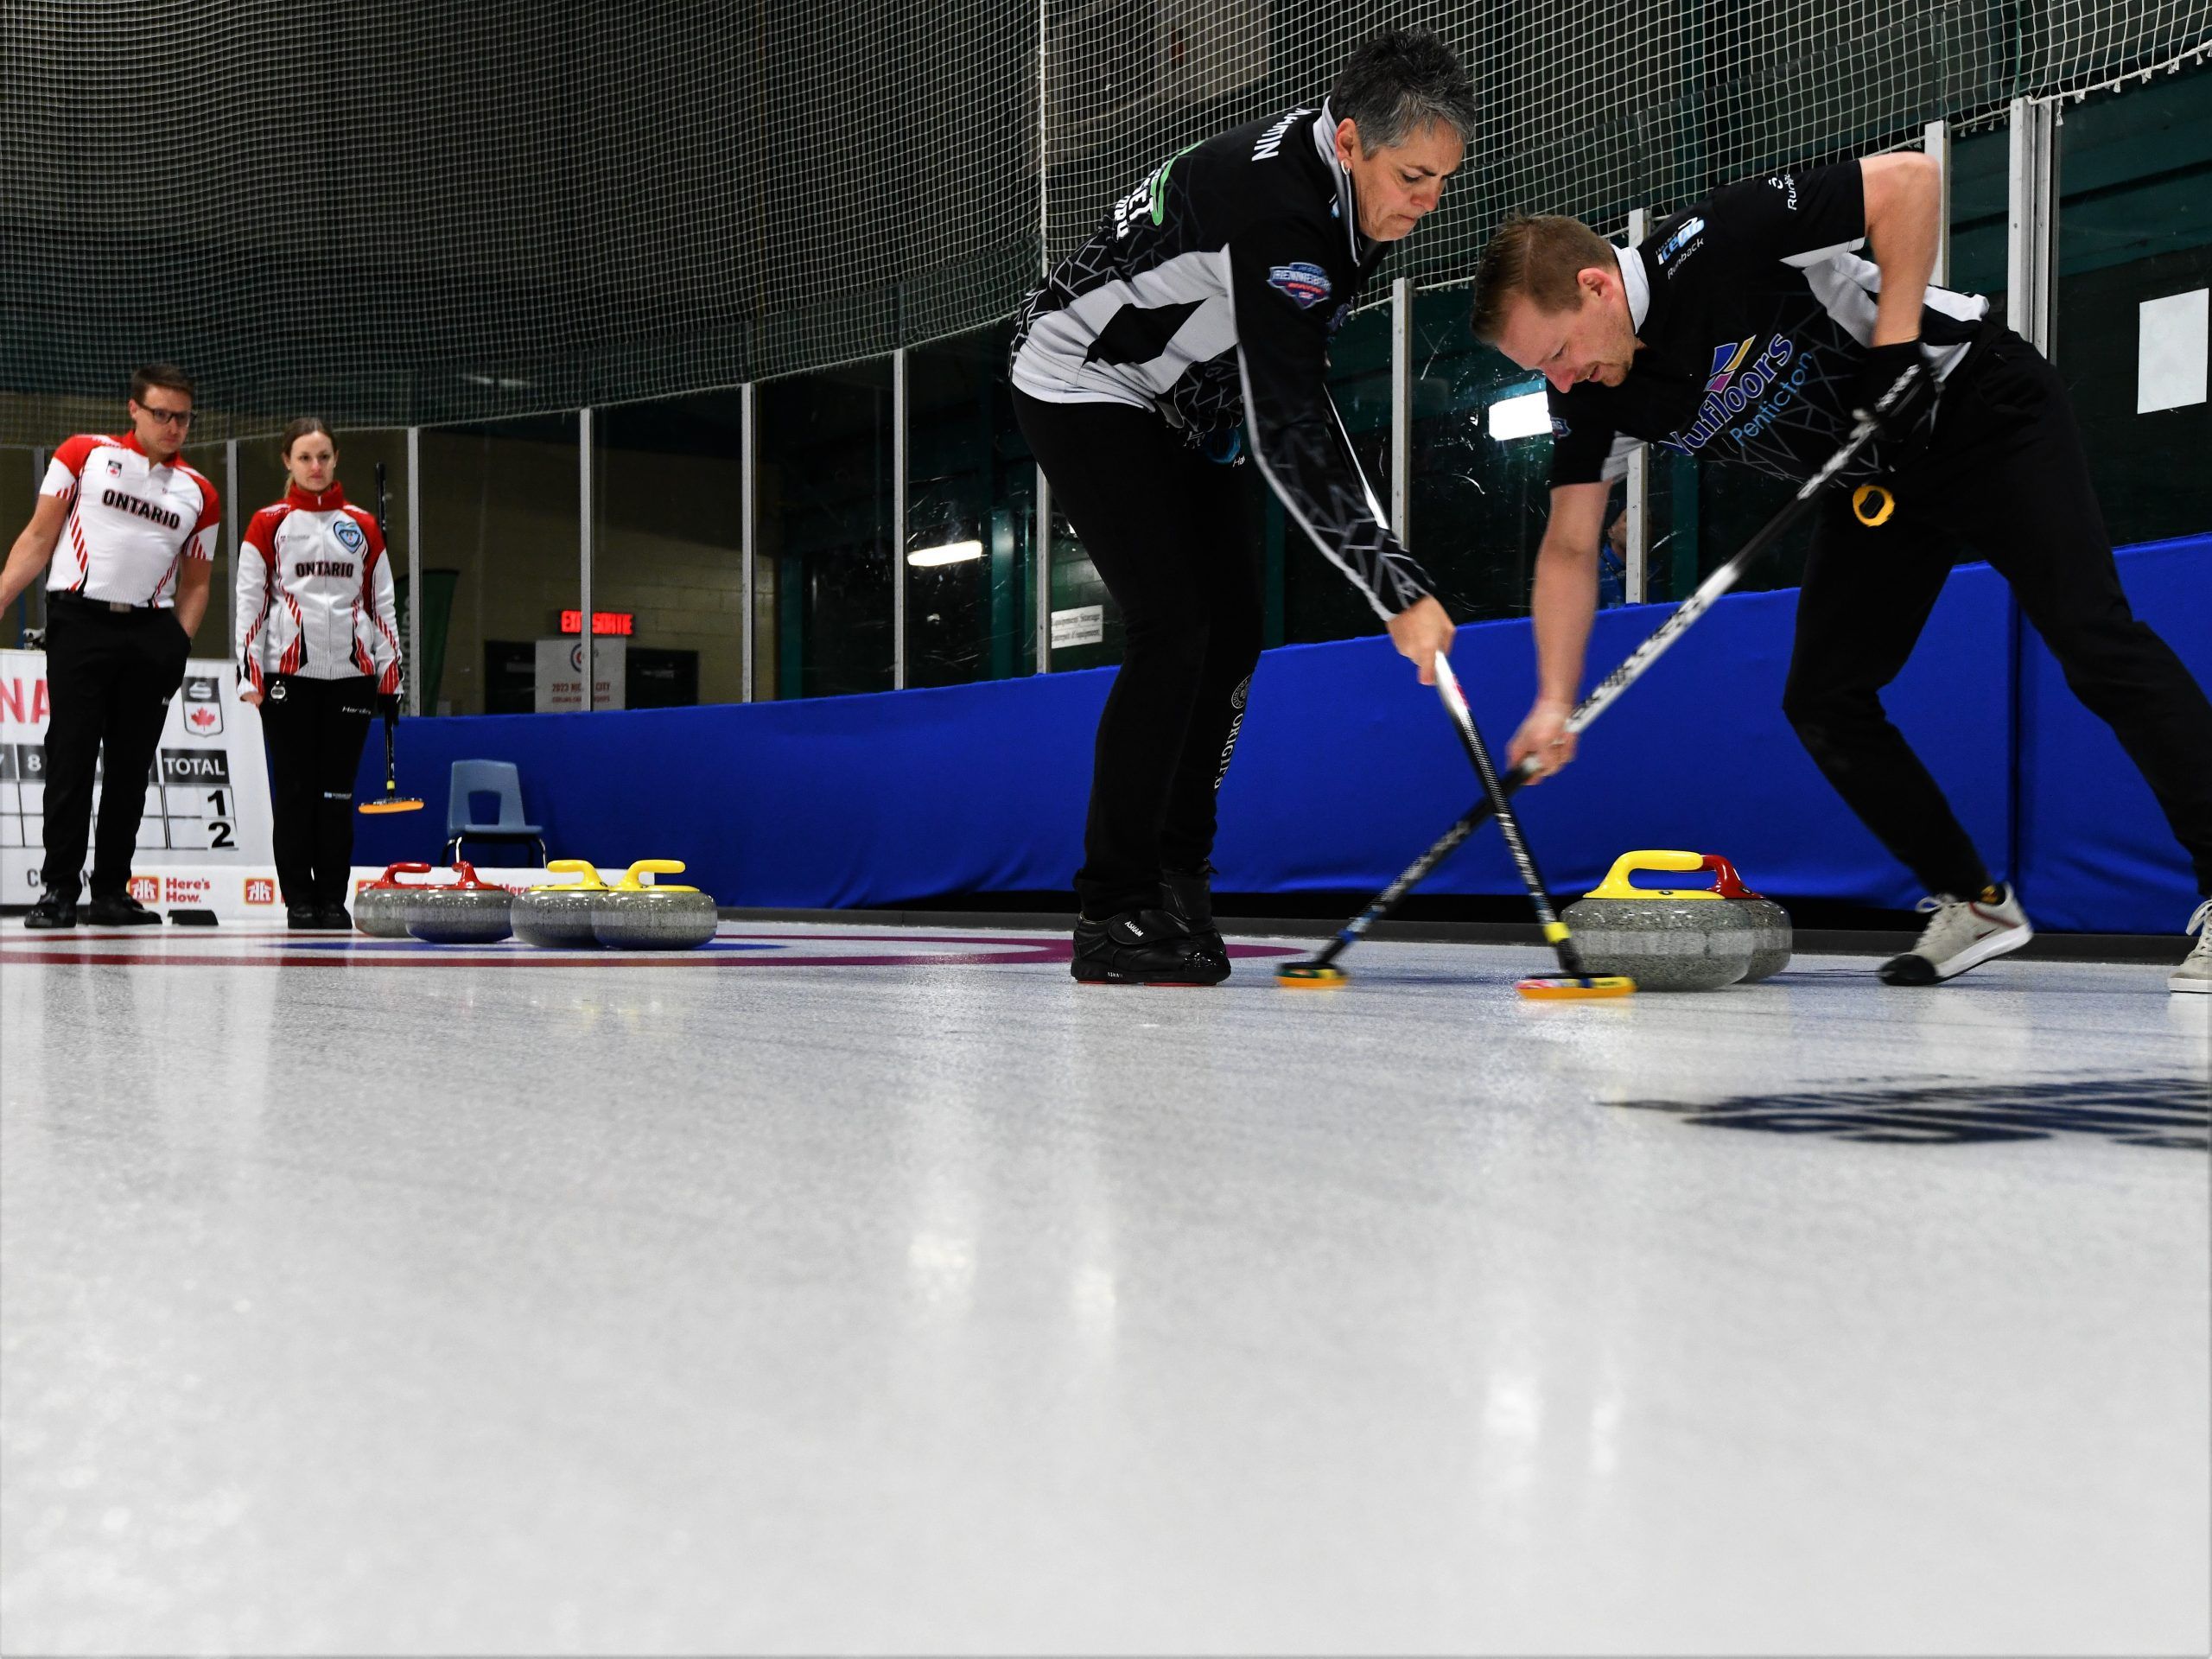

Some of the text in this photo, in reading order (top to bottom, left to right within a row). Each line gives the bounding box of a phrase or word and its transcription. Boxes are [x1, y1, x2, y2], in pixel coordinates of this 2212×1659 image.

[1667, 238, 1705, 280] Runback
[1729, 352, 1813, 448] Penticton
[102, 489, 180, 530] ONTARIO
[296, 562, 354, 578] ONTARIO
[561, 610, 582, 632] EXI
[28, 753, 41, 772] 8
[163, 758, 226, 776] TOTAL
[207, 790, 226, 817] 1
[207, 822, 235, 849] 2
[165, 877, 211, 890] Here's
[165, 891, 202, 903] How.
[1124, 921, 1144, 937] ASHAM
